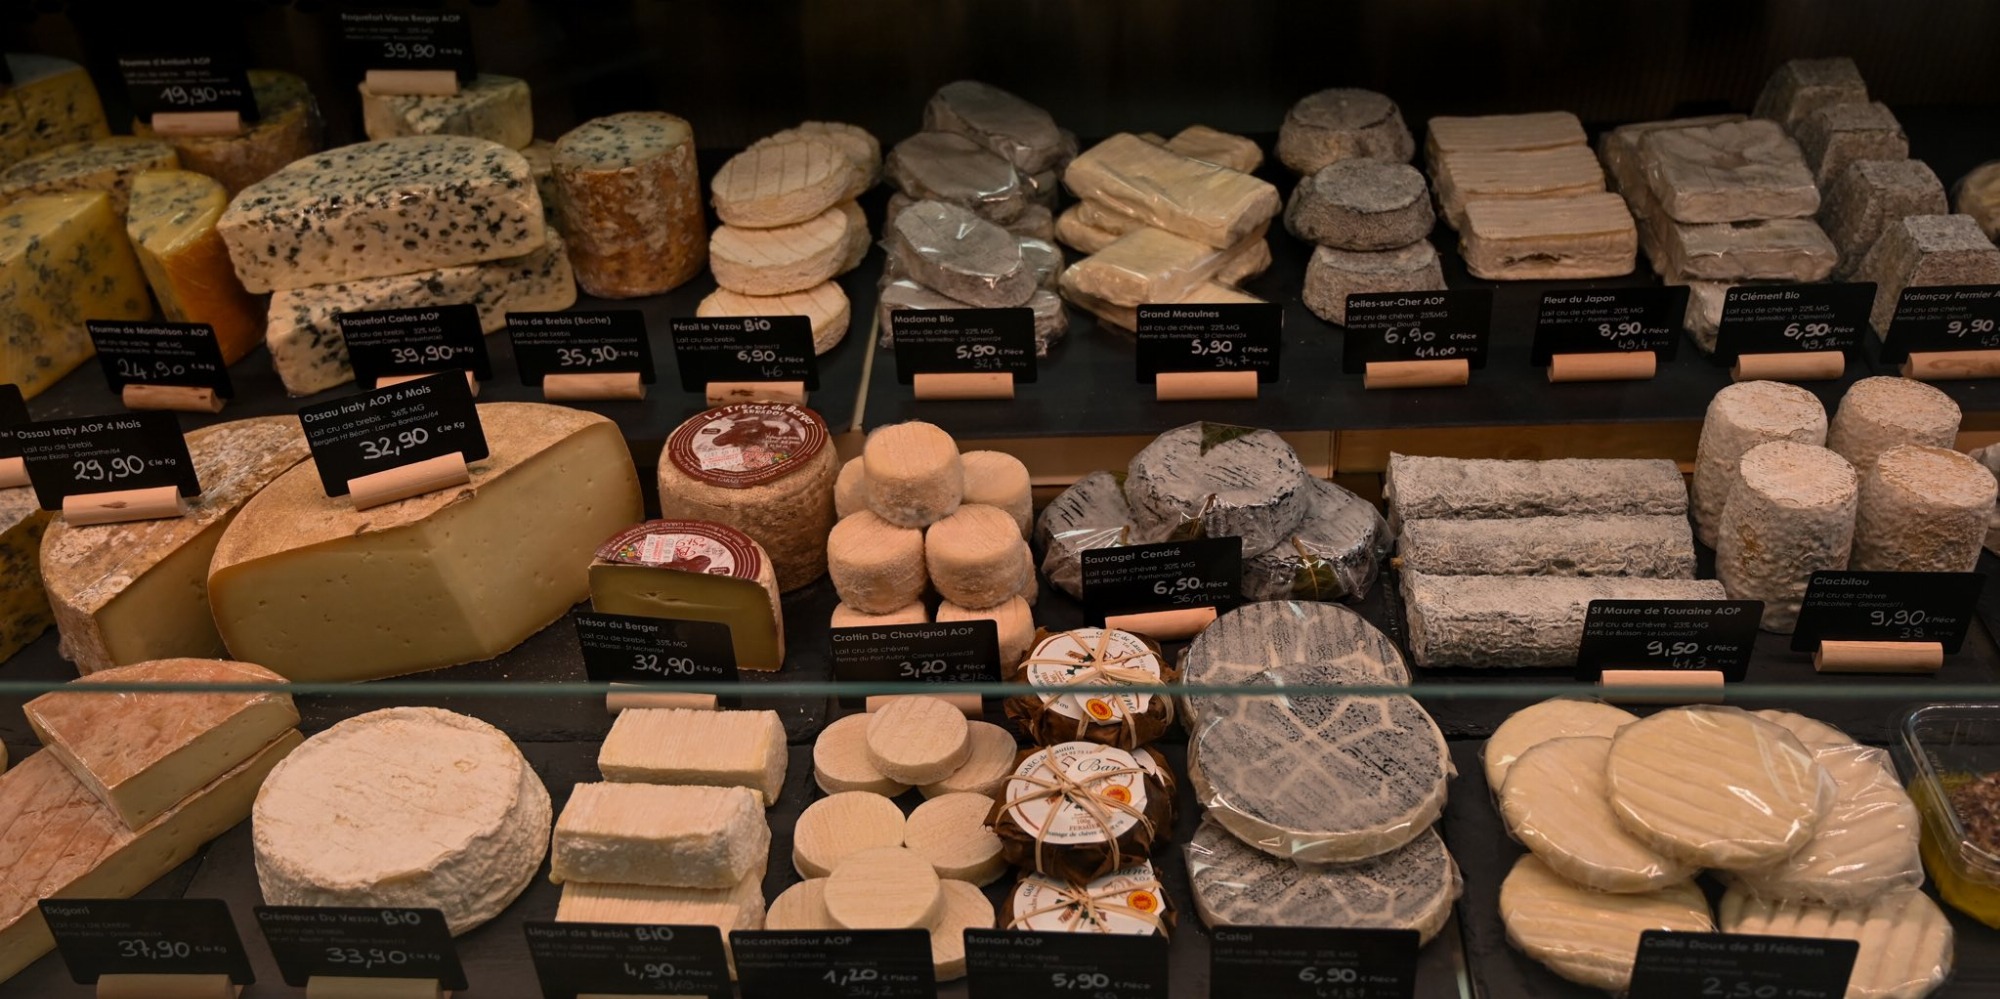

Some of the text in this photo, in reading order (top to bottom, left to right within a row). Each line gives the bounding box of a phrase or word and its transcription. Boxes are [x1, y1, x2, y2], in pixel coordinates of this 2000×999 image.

[384, 42, 435, 60] 39,90
[160, 85, 218, 106] 19,90
[1348, 297, 1444, 308] Selles-sur-Cher AOP
[1585, 296, 1615, 304] Japon
[1740, 291, 1783, 301] Clément
[1903, 293, 1952, 302] Valençay
[342, 312, 440, 327] Roquefort Carles AOP
[509, 318, 528, 326] Bleu
[545, 317, 572, 325] Brebis
[574, 316, 611, 326] (Buche)
[1139, 310, 1219, 318] Grand Meaulnes
[90, 325, 122, 334] Fourme
[123, 326, 134, 334] de
[136, 326, 183, 335] Montbrison
[701, 322, 709, 330] le
[1598, 321, 1641, 340] 8,90
[1784, 323, 1828, 340] 6,90
[1947, 319, 1994, 338] 9,90
[1384, 327, 1436, 344] 6,90
[390, 345, 455, 364] 39,90
[556, 345, 617, 366] 35,90
[956, 344, 996, 359] 5,90
[1190, 339, 1232, 355] 5,90
[737, 350, 776, 363] 6,90
[117, 358, 185, 379] 24,90
[304, 386, 431, 423] Ossau Iraty AOP 6 Mois
[17, 420, 142, 439] Ossau Iraty AOP 4 Mois
[309, 429, 325, 439] Lait
[326, 426, 340, 434] cru
[342, 422, 354, 430] de
[356, 415, 381, 426] brebis
[409, 404, 425, 413] MG
[22, 446, 36, 454] Lait
[55, 444, 66, 452] de
[67, 442, 93, 450] brebis
[358, 421, 465, 460] 32,90 le Kg
[73, 455, 144, 482] 29,90
[165, 458, 176, 466] Kg
[1084, 548, 1181, 565] Sauvaget Cendré
[1153, 577, 1228, 595] 6,50 Pièce
[1813, 577, 1870, 586] Clacbitou
[1604, 607, 1639, 615] Maure
[1644, 607, 1659, 615] de
[1662, 607, 1711, 615] Touraine
[1714, 607, 1741, 615] AOP
[1870, 610, 1925, 627] 9,90
[577, 618, 658, 632] Trésor du Berger
[1900, 627, 1924, 638] 38
[833, 627, 974, 642] Crottin De Chavignol AOP
[1646, 640, 1738, 657] 9,50 Pièce
[632, 654, 695, 676] 32,90
[712, 666, 722, 674] Kg
[899, 659, 985, 678] 3,20 Pièce
[319, 913, 336, 922] Du
[570, 928, 587, 937] de
[118, 939, 190, 959] 37,90
[735, 937, 852, 946] Rocamadour AOP
[1014, 937, 1043, 946] AOP
[1689, 940, 1725, 951] Doux
[1729, 942, 1748, 952] de
[1769, 943, 1824, 955] Félicien
[326, 947, 407, 968] 33,90
[624, 962, 675, 980] 4,90
[823, 968, 878, 986] 1,20
[1298, 967, 1357, 984] 6,90
[1051, 973, 1109, 989] 5,90
[1701, 977, 1778, 998] 2,50
